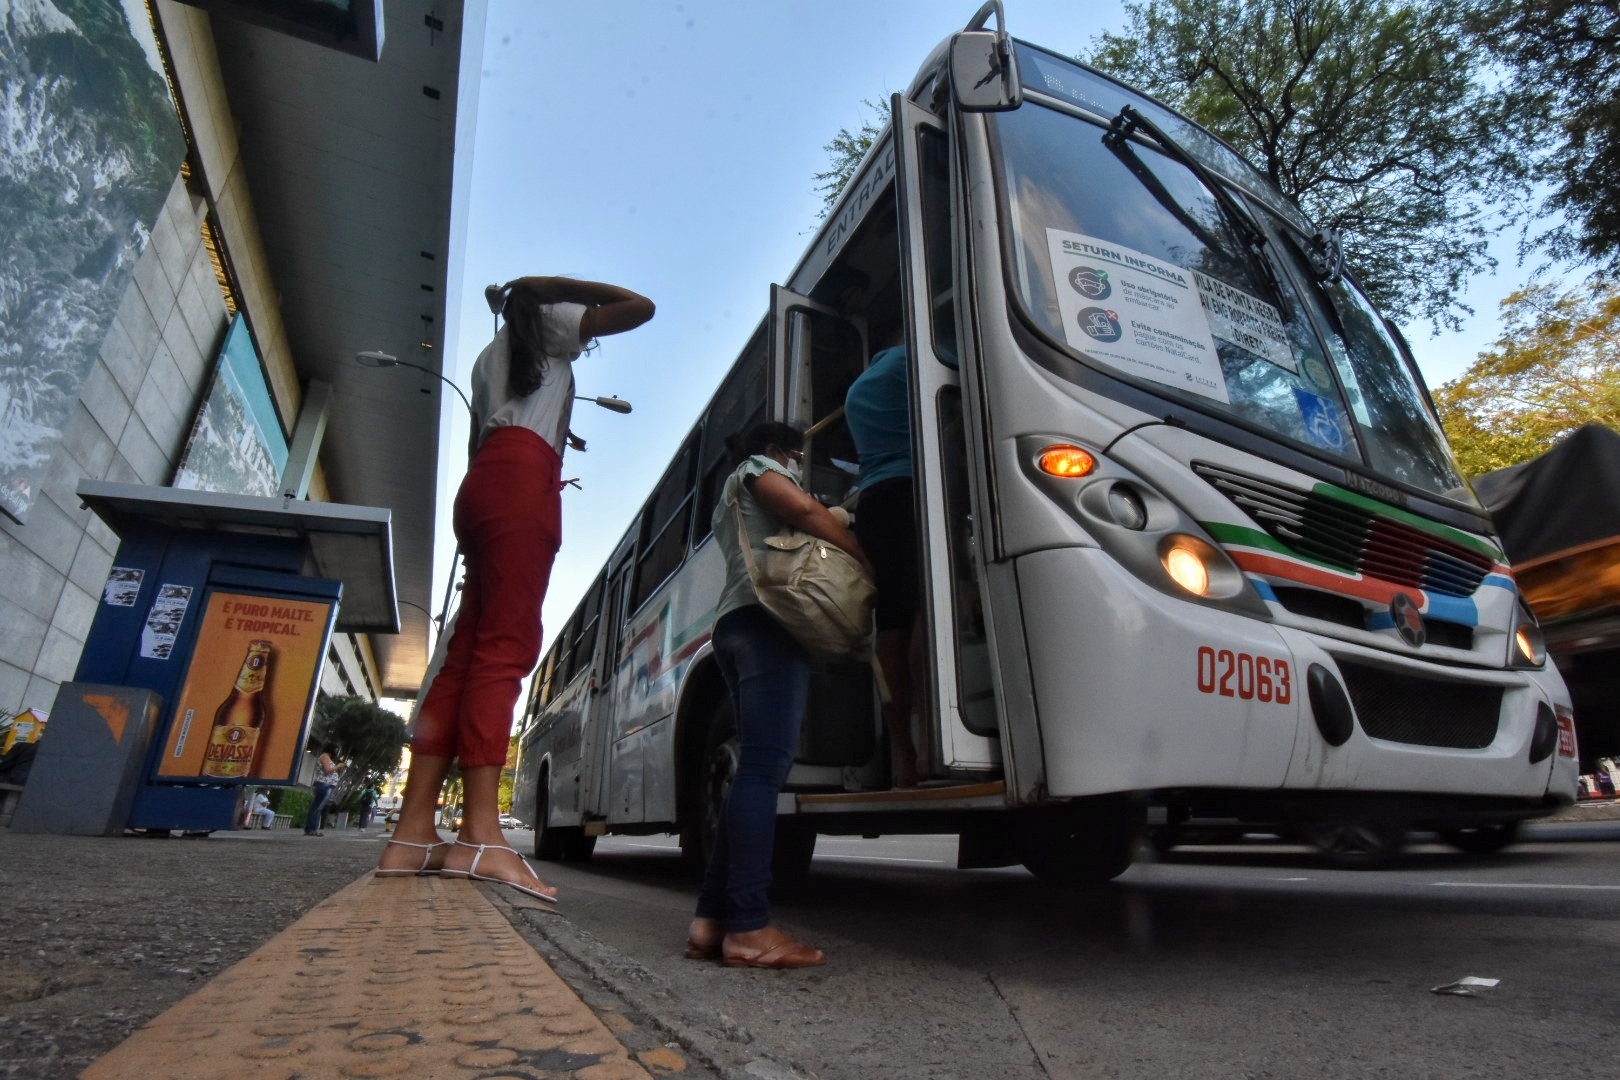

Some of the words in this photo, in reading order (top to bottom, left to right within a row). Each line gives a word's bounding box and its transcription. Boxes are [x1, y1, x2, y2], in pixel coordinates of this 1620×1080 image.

[1062, 240, 1121, 261] SETURN
[1124, 255, 1187, 284] INFORMA
[1120, 279, 1136, 289] Uso
[1123, 288, 1132, 296] de
[1213, 280, 1226, 299] DE
[1225, 286, 1254, 312] PONTA
[1253, 301, 1280, 323] NEGRA
[1131, 320, 1152, 332] Evite
[233, 602, 269, 618] PURO
[270, 605, 314, 622] MALTE.
[236, 619, 300, 636] TROPICAL.
[1197, 645, 1290, 705] 02063
